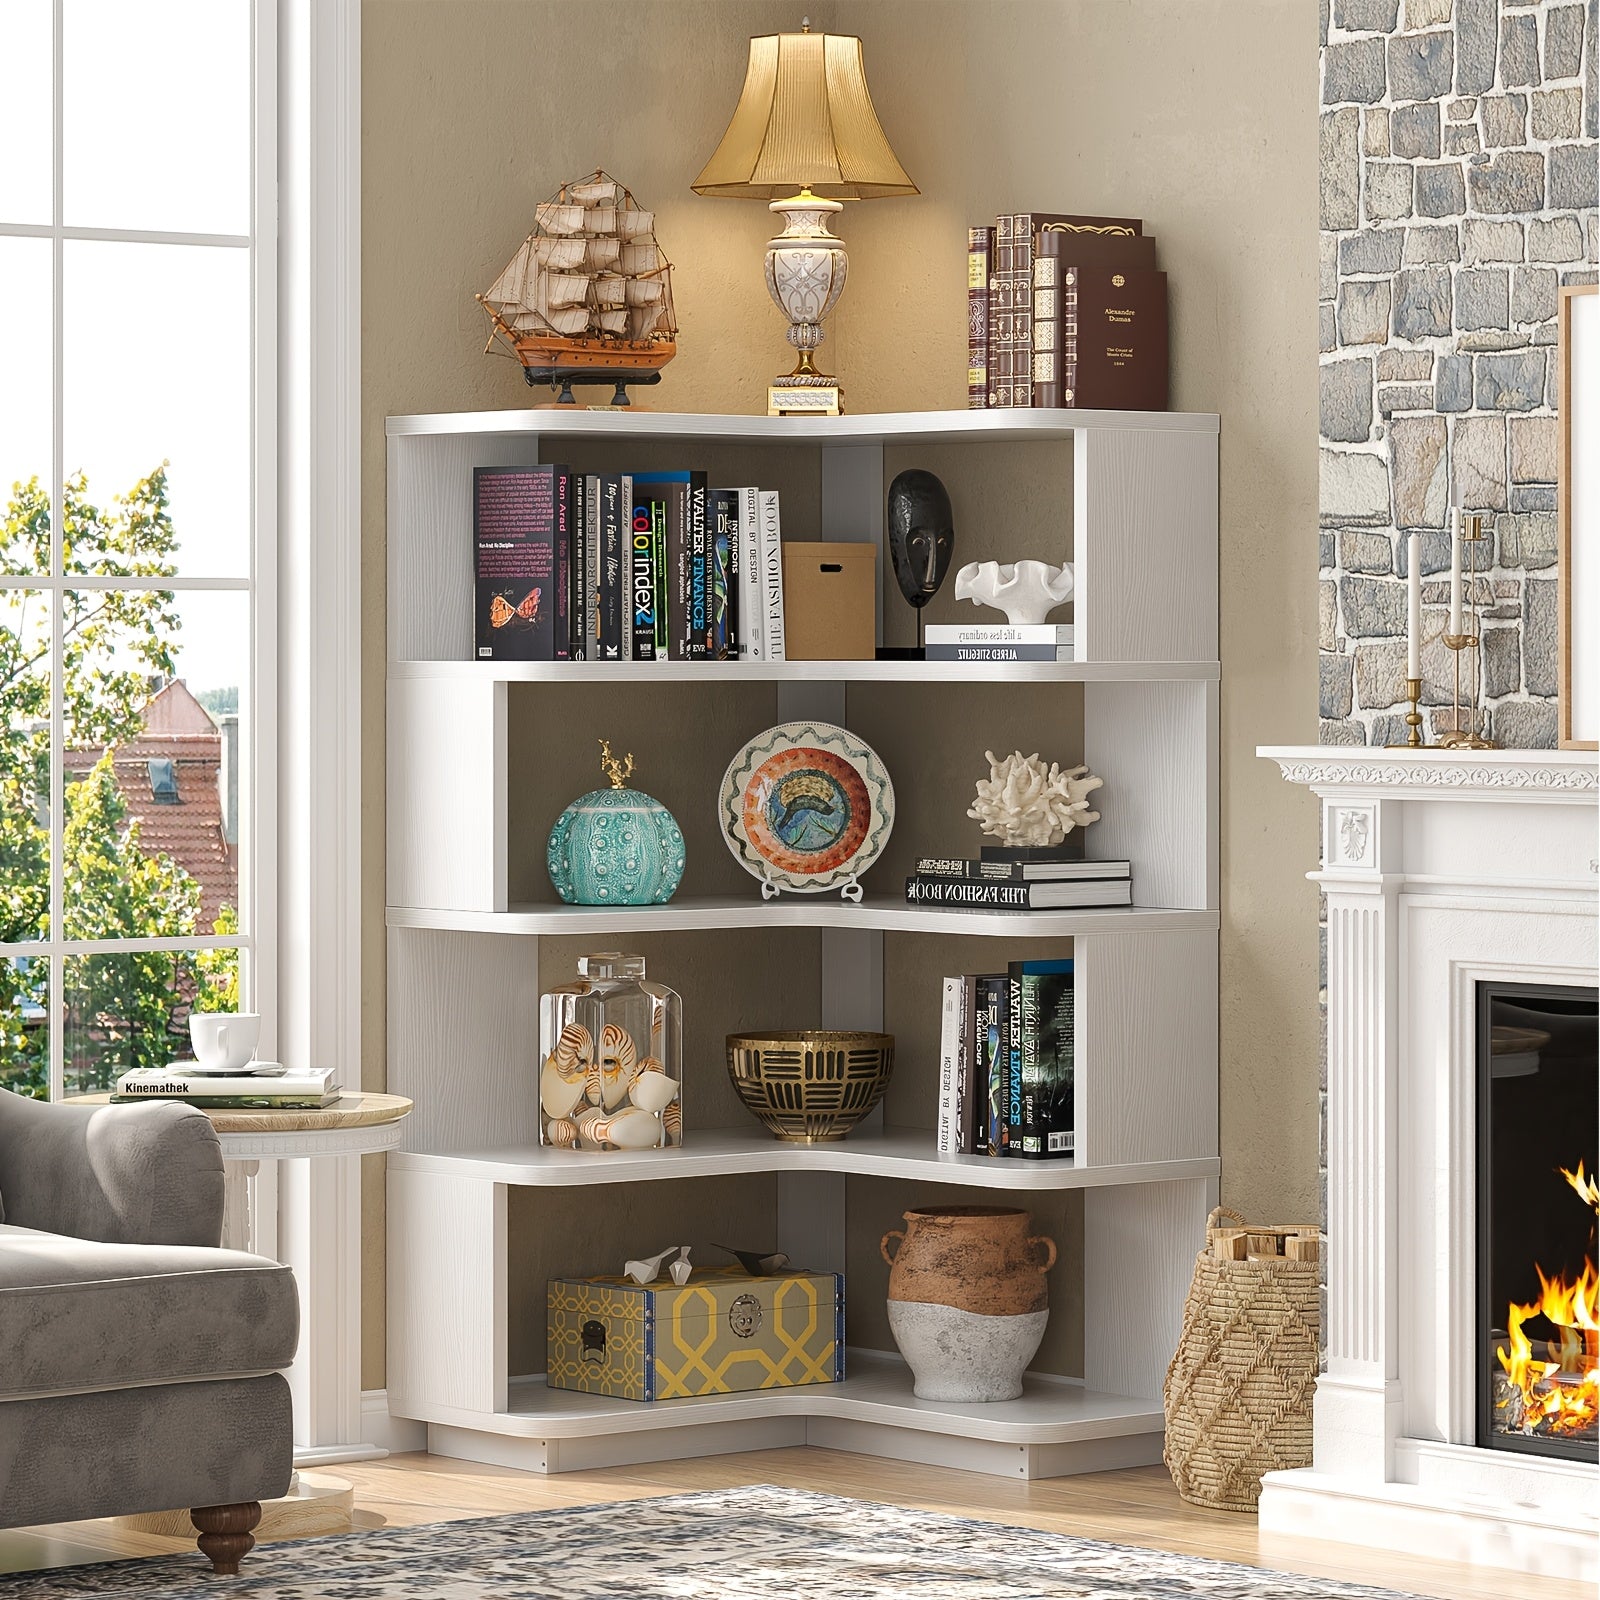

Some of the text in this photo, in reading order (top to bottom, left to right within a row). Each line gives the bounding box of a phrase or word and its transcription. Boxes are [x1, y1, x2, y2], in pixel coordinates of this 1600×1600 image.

[1105, 308, 1135, 316] Alexandre
[559, 504, 567, 532] Arad
[588, 488, 596, 636] INNENARCHITEKTUR
[693, 487, 704, 629] WALTER FINANCE
[748, 489, 758, 584] DIGITAL BY DESIGN
[765, 495, 782, 659] THE FASHION BOOK
[126, 1083, 189, 1093] Kinemathek
